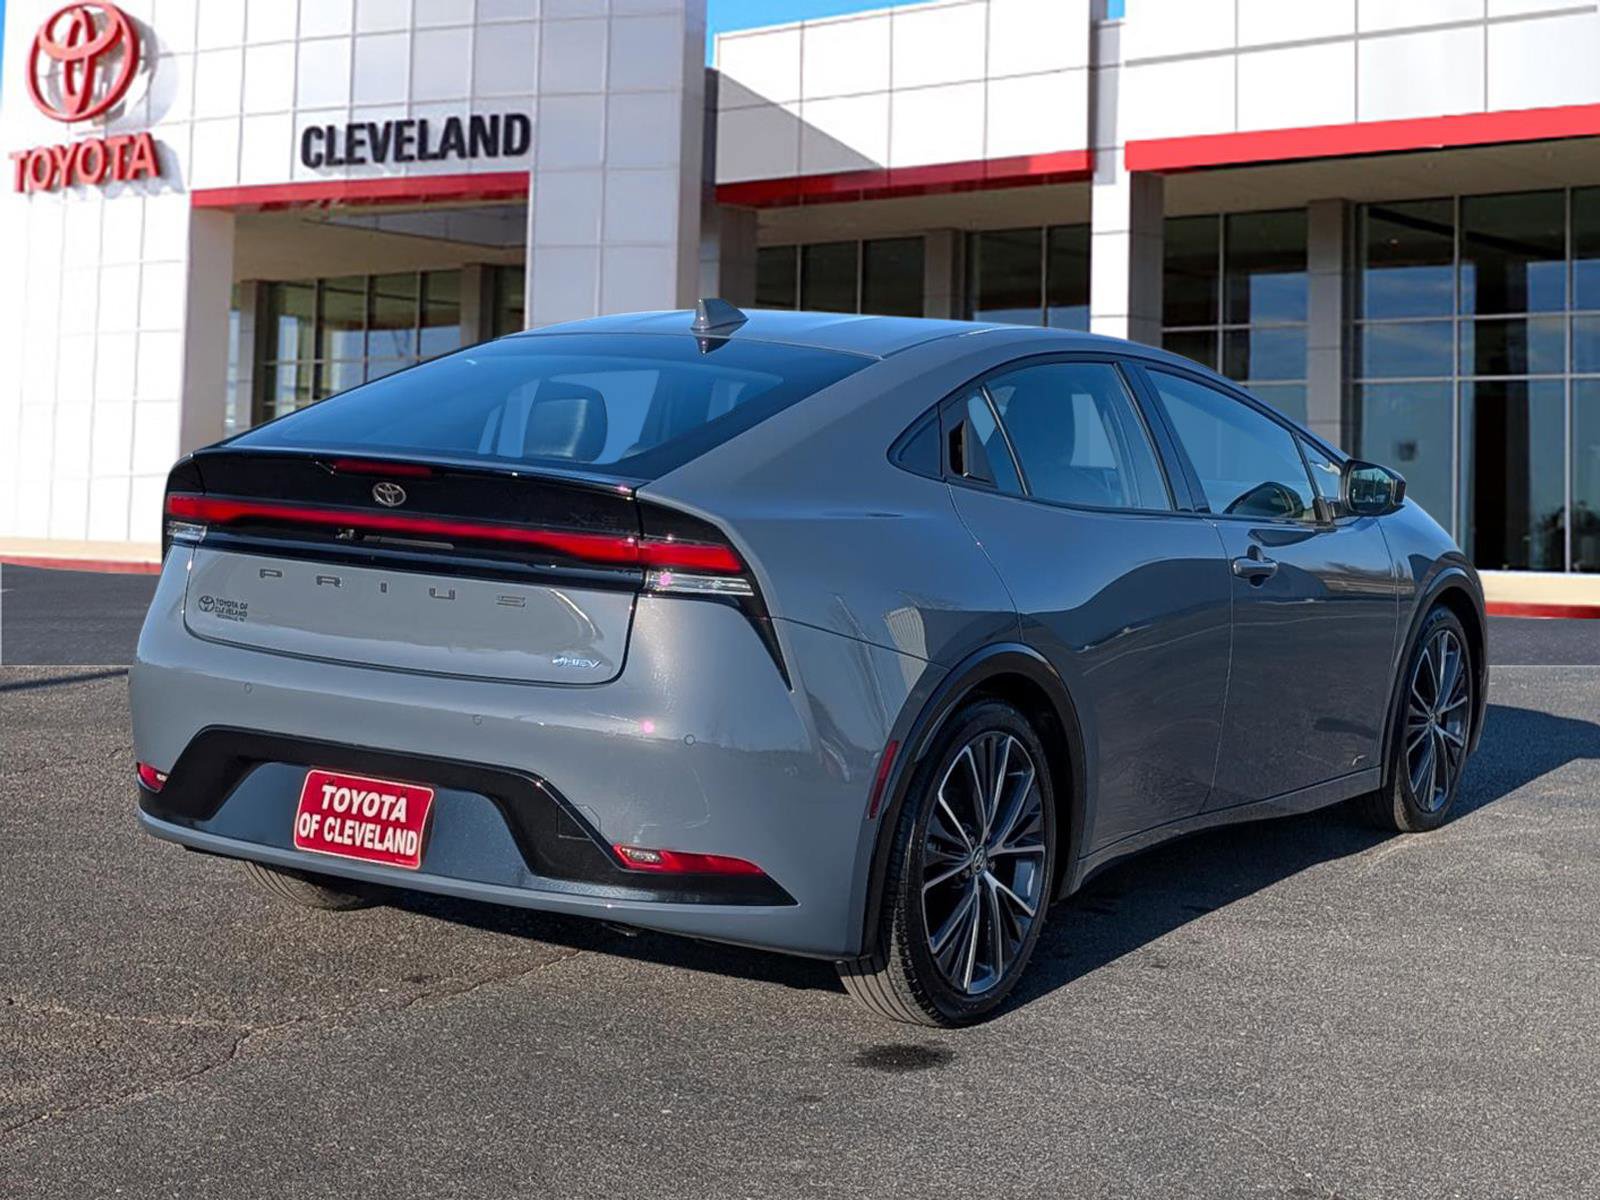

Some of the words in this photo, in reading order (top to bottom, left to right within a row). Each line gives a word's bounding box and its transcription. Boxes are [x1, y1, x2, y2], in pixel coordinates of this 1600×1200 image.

[301, 113, 531, 169] CLEVELAND
[9, 131, 160, 193] TOYOTA
[215, 598, 239, 609] TOYOTA
[259, 568, 526, 607] PRIUS
[321, 784, 407, 823] TOYOTA
[298, 812, 321, 839] OF
[323, 816, 418, 856] CLEVELAND
